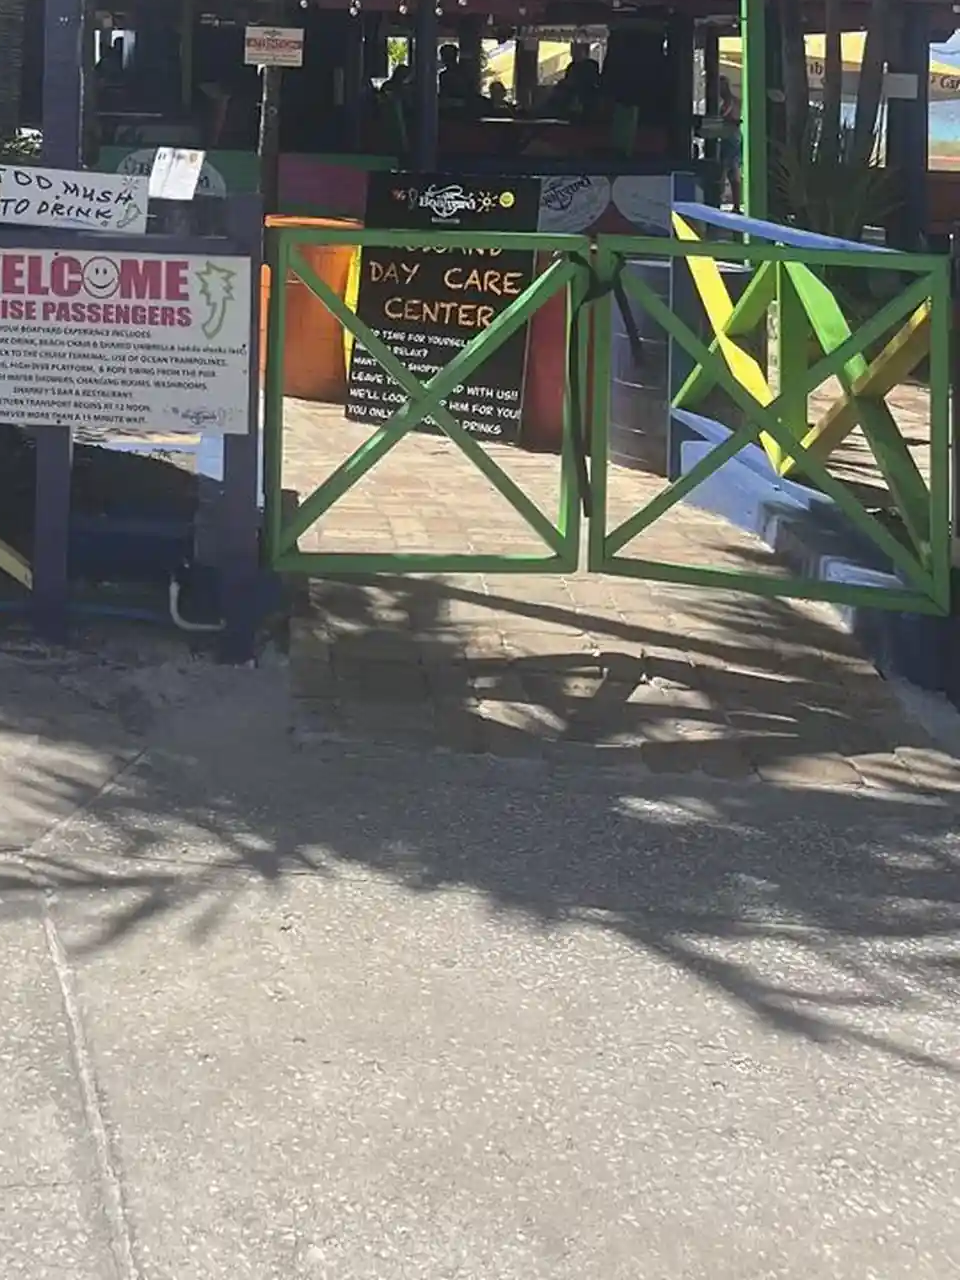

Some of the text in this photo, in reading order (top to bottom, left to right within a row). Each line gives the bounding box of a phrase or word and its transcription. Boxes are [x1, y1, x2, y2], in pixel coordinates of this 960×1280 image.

[0, 198, 112, 220] TO DRINK
[369, 261, 523, 296] DAY CARE
[43, 303, 192, 328] PASSENGERS
[384, 297, 495, 327] CENTER
[382, 330, 406, 342] TIME
[408, 334, 426, 343] FOR
[427, 335, 470, 348] YOURSEL
[23, 351, 38, 359] THE
[39, 351, 67, 360] CRUISE
[140, 356, 168, 364] OCEAN
[393, 346, 429, 360] RELAX?
[353, 356, 377, 367] WANT
[408, 362, 443, 374] SHOPP
[157, 368, 180, 376] FROM
[76, 377, 119, 386] CHANGING
[351, 371, 383, 385] LEAVE
[466, 386, 494, 398] WITH
[26, 399, 72, 408] TRANSPORT
[349, 388, 380, 401] WE'LL
[449, 400, 470, 412] HIM
[471, 403, 494, 417] FOR
[0, 410, 25, 418] NEVER
[26, 411, 49, 419] MORE
[93, 414, 124, 423] MINUTE
[347, 404, 503, 435] YOU ONLY DRINKS
